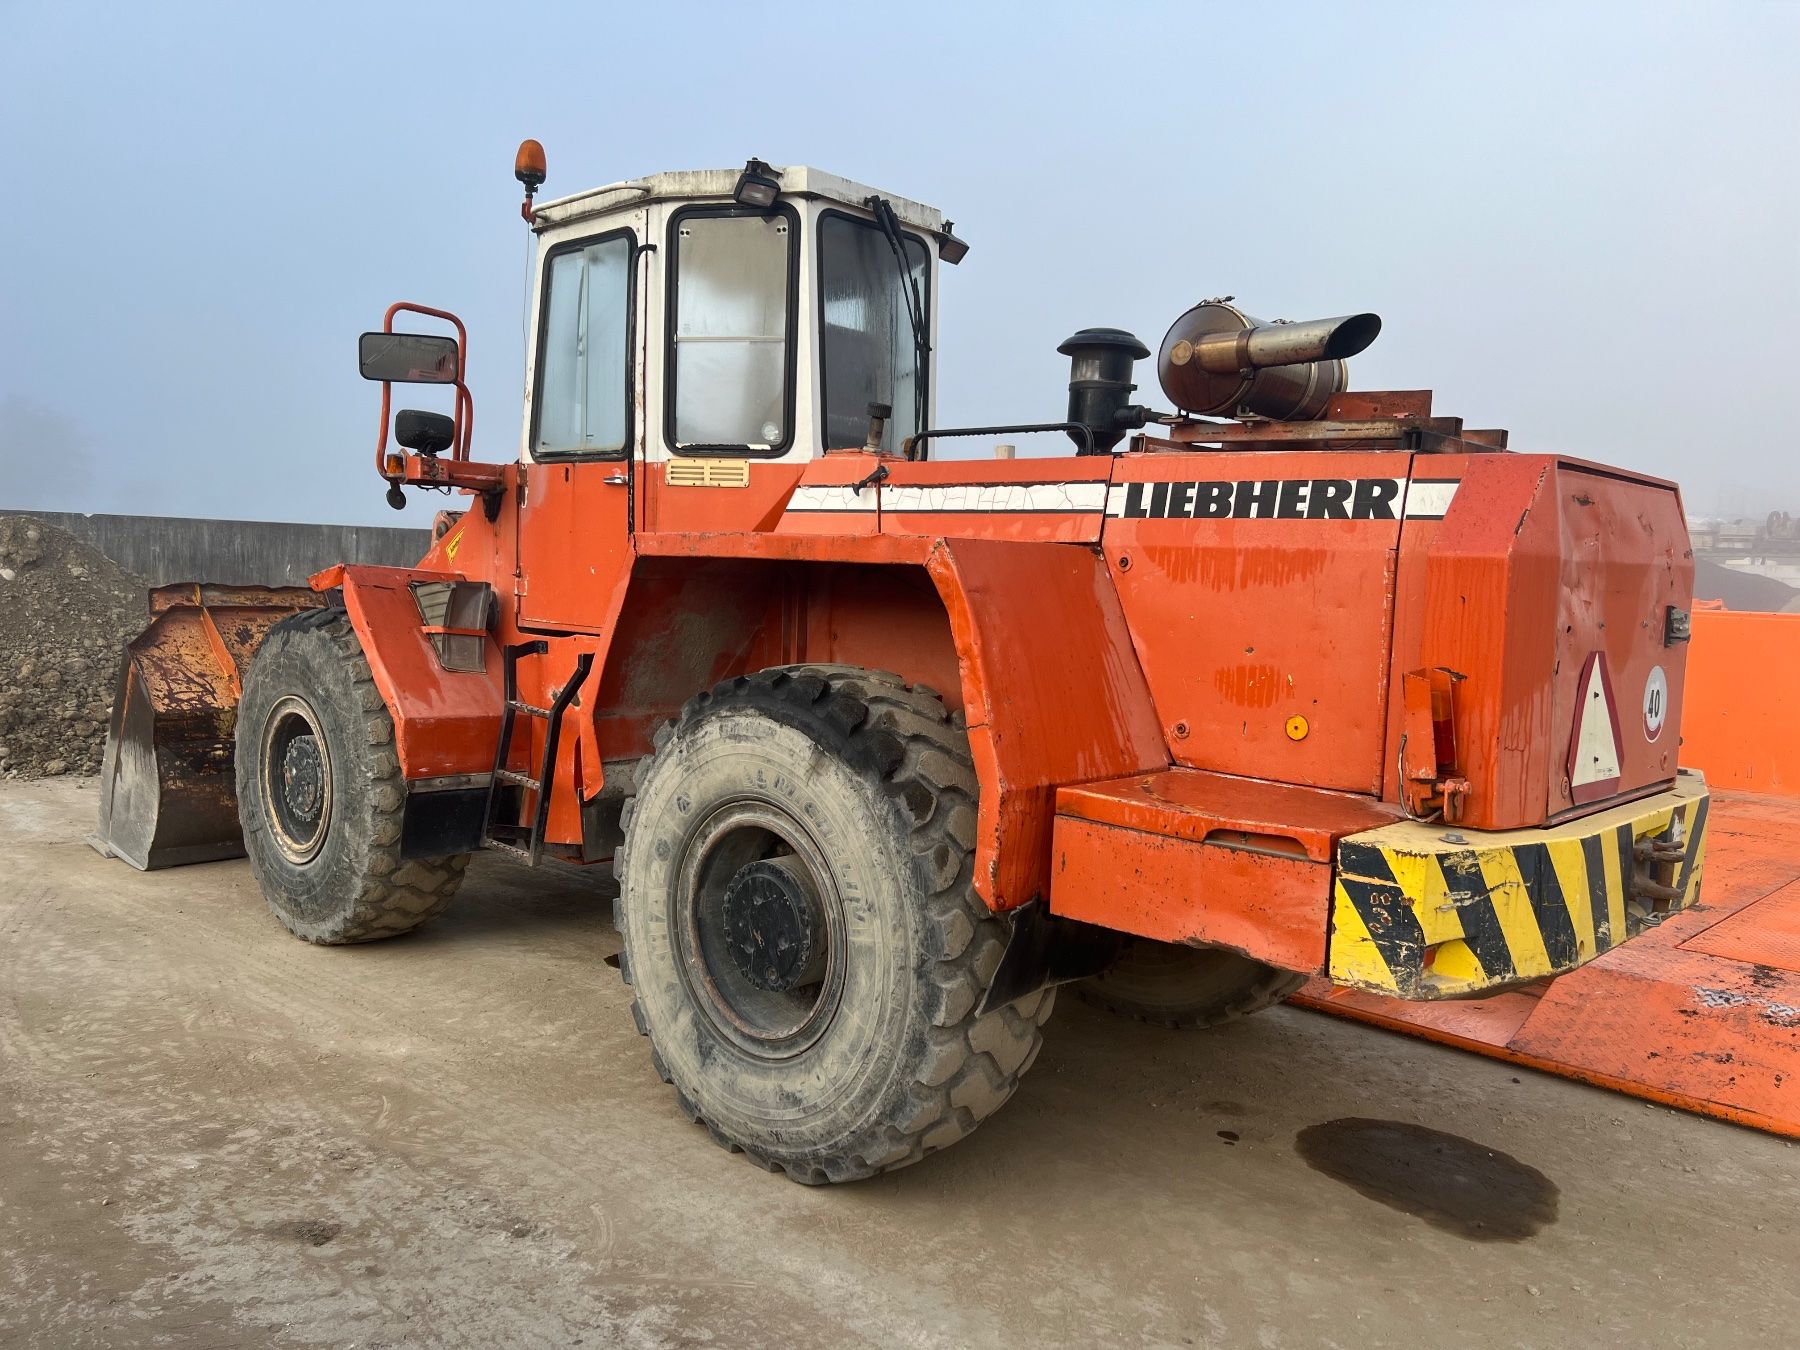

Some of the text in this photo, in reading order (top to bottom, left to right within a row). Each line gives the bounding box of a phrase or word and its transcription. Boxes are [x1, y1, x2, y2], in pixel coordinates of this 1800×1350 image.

[1123, 478, 1399, 519] LIEBHERR
[1648, 689, 1660, 718] 40
[773, 775, 867, 922] MICHELIN
